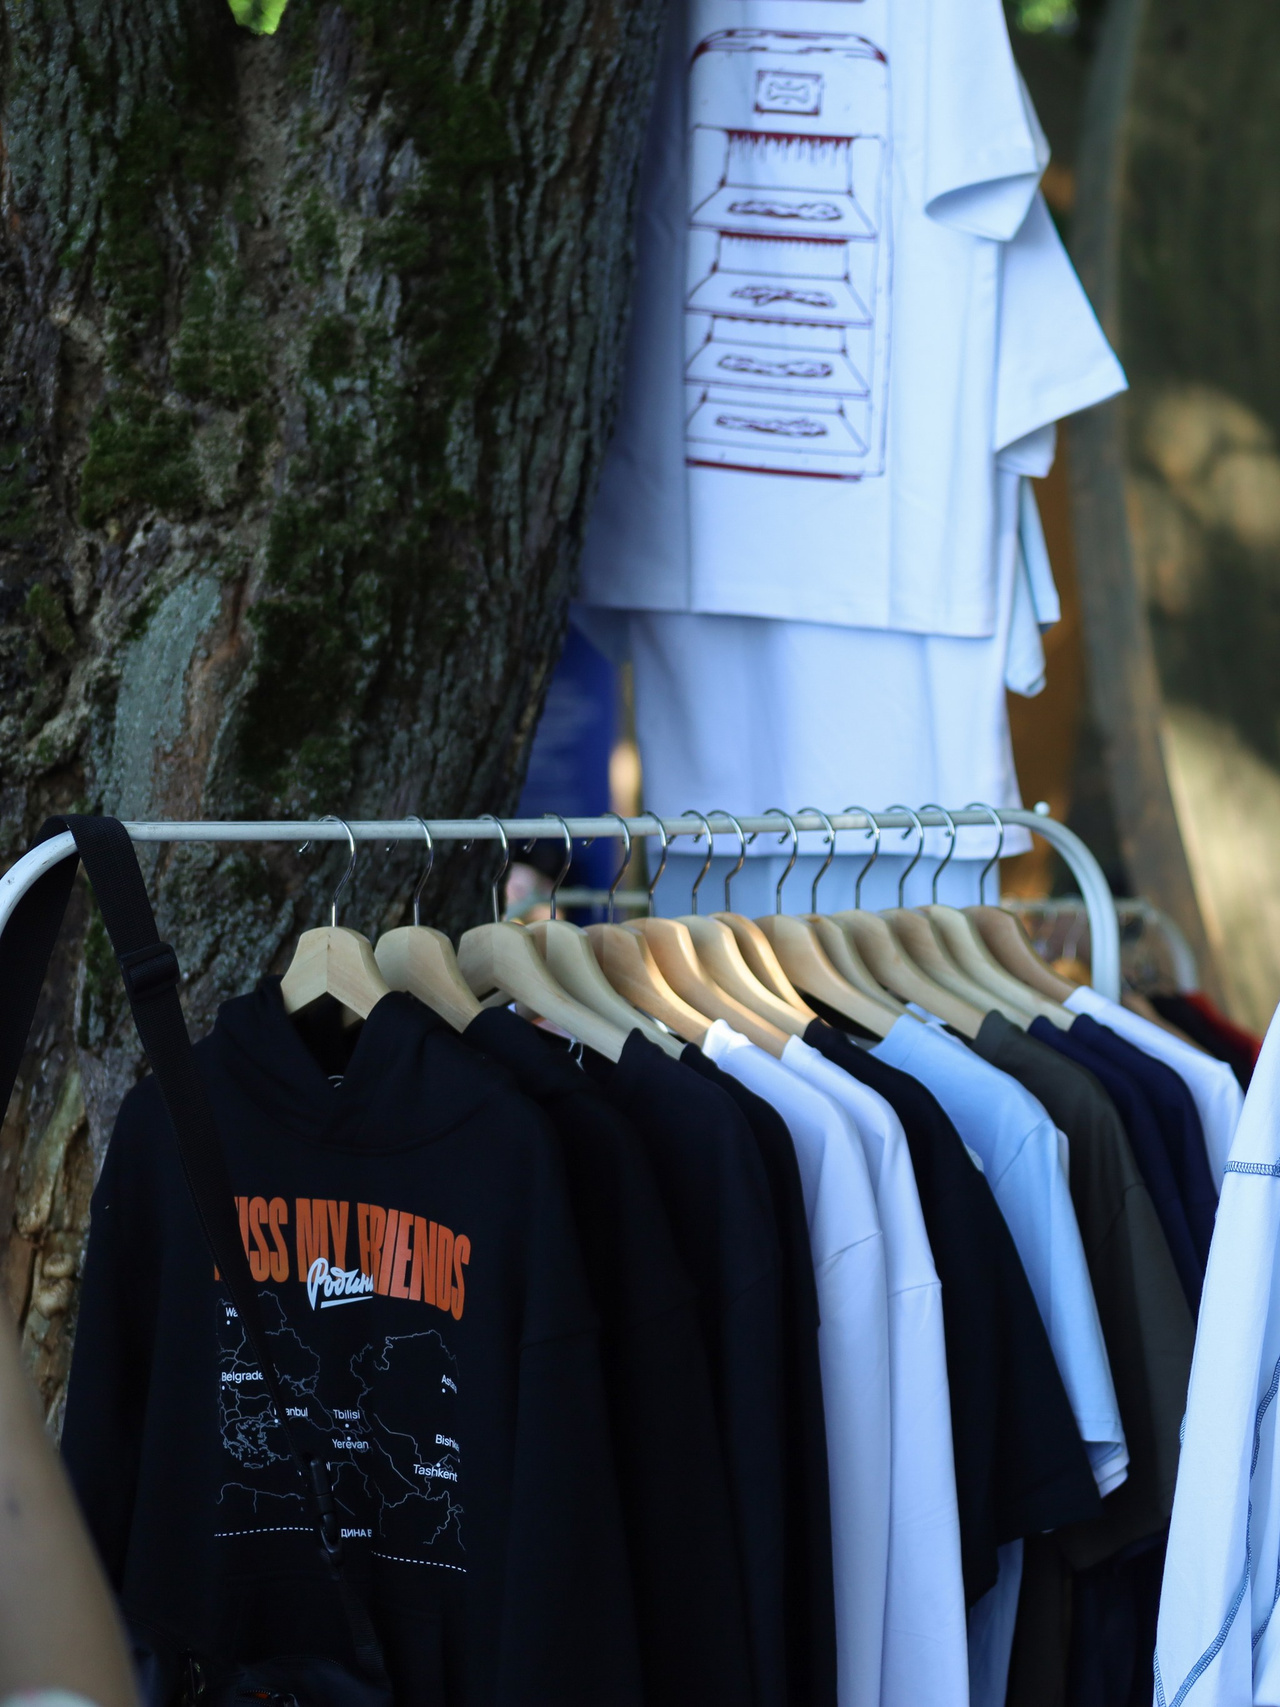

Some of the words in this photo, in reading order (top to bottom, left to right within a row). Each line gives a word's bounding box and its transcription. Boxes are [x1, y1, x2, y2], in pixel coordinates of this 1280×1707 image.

[296, 1197, 350, 1284] MY
[357, 1202, 472, 1321] FRIENDS
[306, 1256, 374, 1312] Родин
[332, 1408, 361, 1420] Tbilisi
[331, 1438, 370, 1450] Yerevan
[413, 1463, 458, 1483] Tashkent
[340, 1528, 367, 1538] ДИНА
